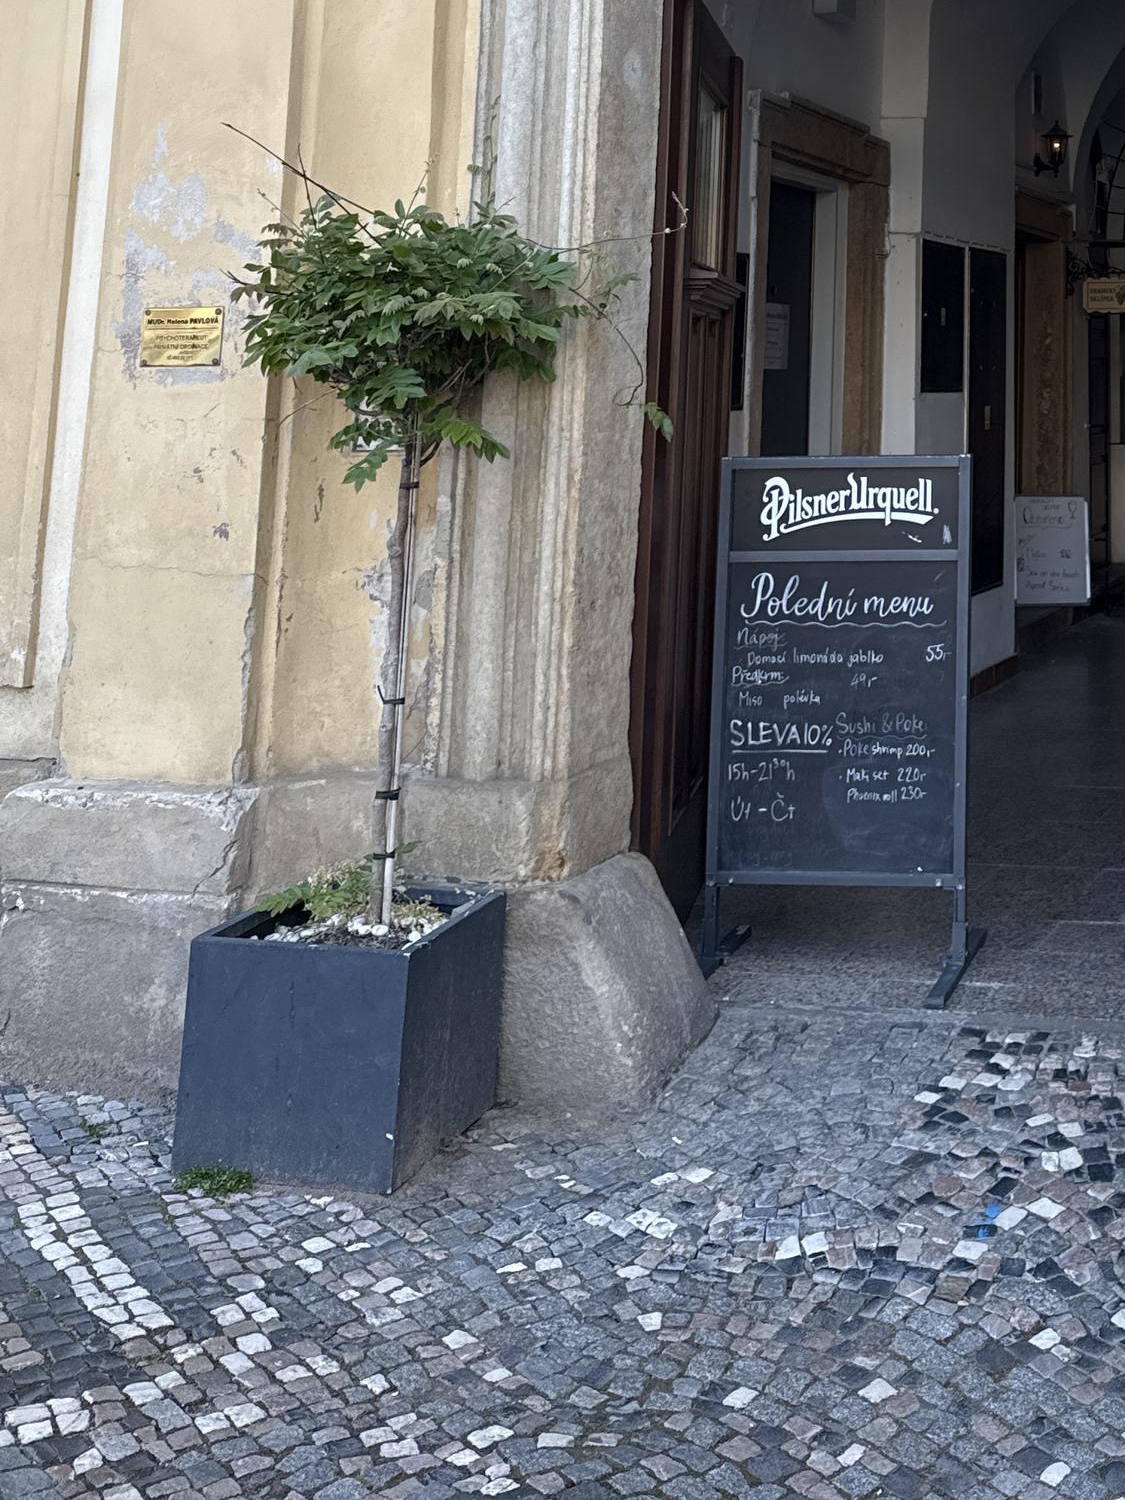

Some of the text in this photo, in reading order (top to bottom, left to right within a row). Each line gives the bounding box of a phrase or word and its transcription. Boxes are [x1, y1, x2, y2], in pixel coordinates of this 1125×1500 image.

[189, 316, 219, 325] PAVLOVÁ
[760, 476, 851, 541] Pilsner
[740, 572, 935, 621] Polední menu
[729, 719, 801, 746] SLEVA
[835, 711, 877, 734] Sushi
[881, 712, 895, 733] &
